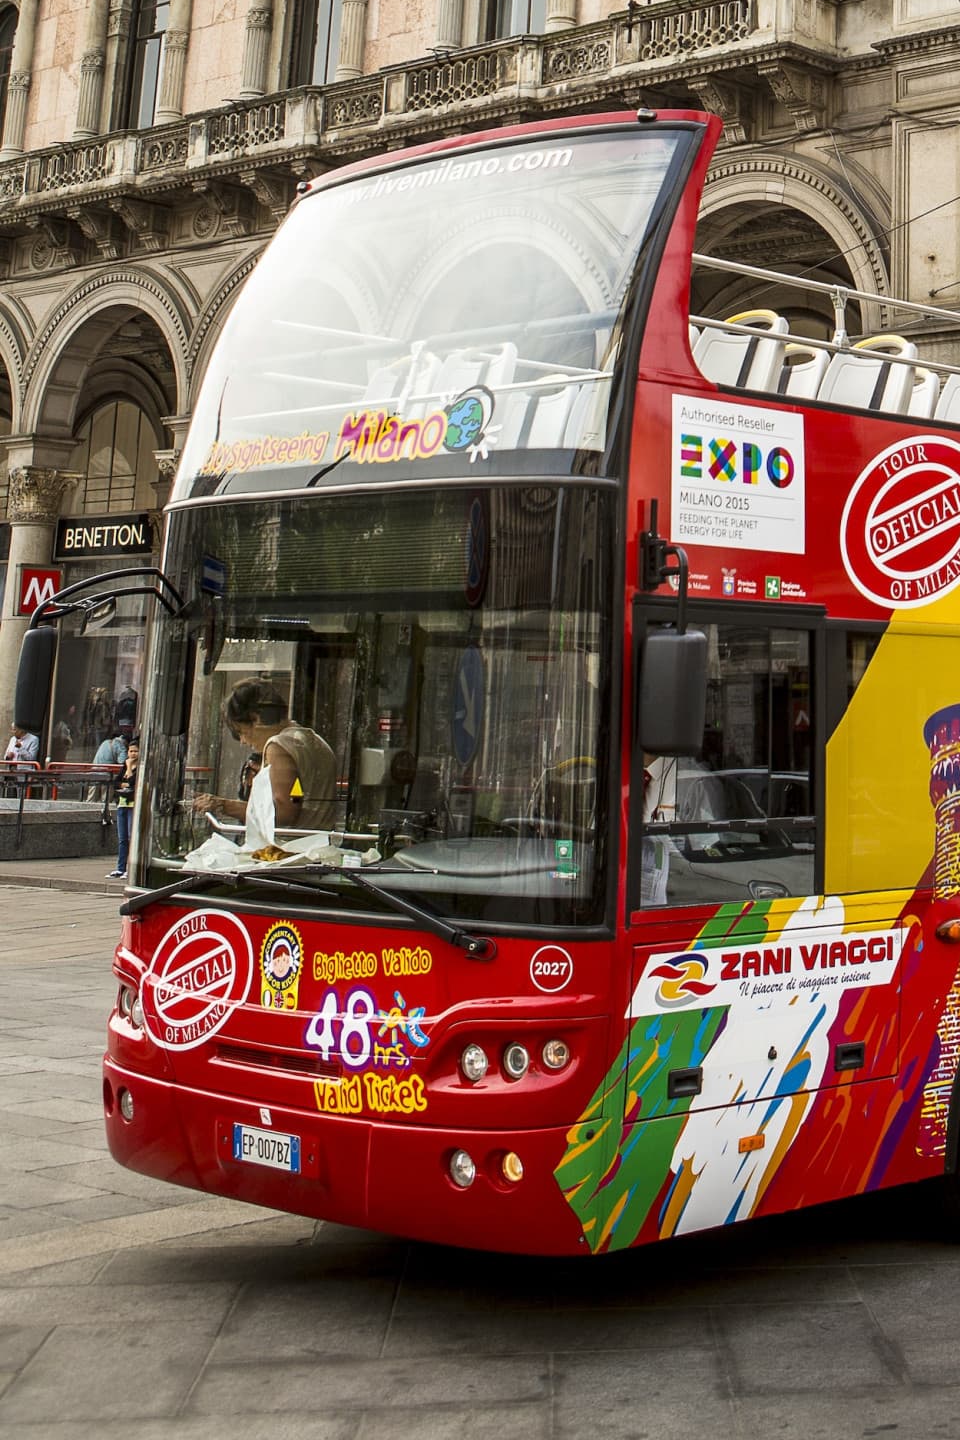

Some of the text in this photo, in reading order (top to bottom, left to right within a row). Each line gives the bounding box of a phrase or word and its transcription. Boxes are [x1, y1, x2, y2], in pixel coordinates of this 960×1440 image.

[681, 407, 776, 432] Authorised Reseller
[335, 409, 447, 464] Milano
[680, 433, 795, 489] EXPO
[879, 444, 928, 479] TOUR
[680, 492, 750, 510] MILANO 2015
[680, 513, 759, 529] FEEDING THE PLANET
[680, 525, 744, 540] ENERGY FOR LIFE
[64, 524, 146, 549] BENETTON.
[890, 580, 912, 600] OF
[173, 915, 208, 945] TOUR
[265, 930, 297, 953] COMMENTARY
[313, 946, 432, 985] Biglietto Valido
[534, 962, 568, 976] 2027
[721, 936, 894, 980] ZANI VIAGGI
[269, 972, 296, 990] FOR KIDS
[750, 980, 784, 998] piacere
[786, 977, 796, 991] di
[799, 974, 839, 994] viaggiare
[841, 970, 872, 984] insieme
[165, 1002, 226, 1043] OF MILANO
[306, 990, 375, 1067] 48
[314, 1071, 428, 1114] Valid Ticket
